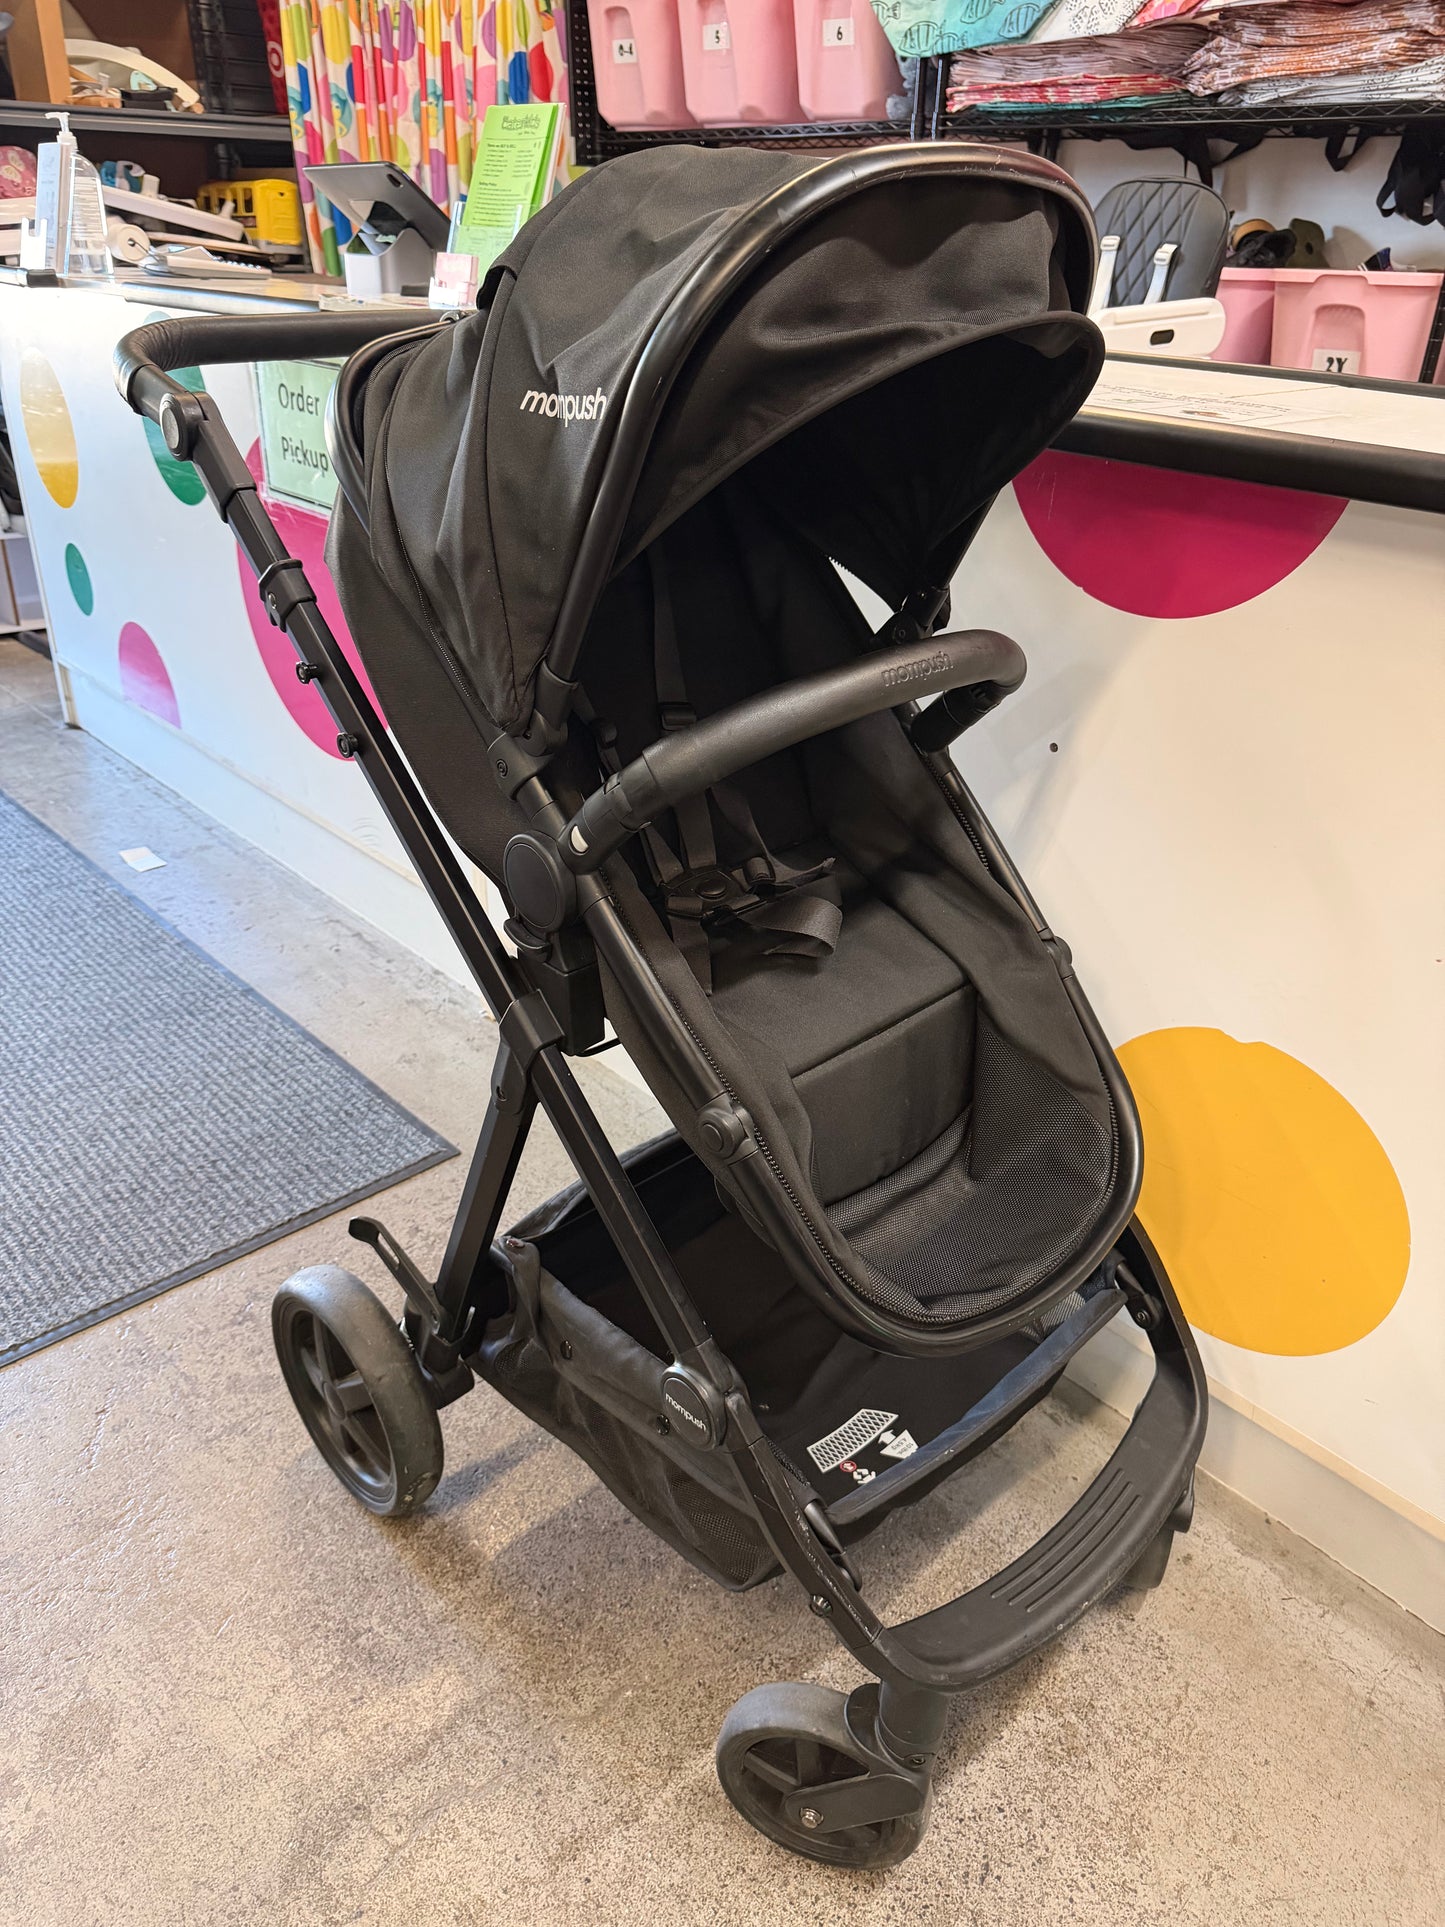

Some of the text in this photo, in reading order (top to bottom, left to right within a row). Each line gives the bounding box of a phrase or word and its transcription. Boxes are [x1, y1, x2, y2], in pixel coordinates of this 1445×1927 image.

[714, 29, 721, 44] 5
[836, 26, 843, 41] 6
[278, 383, 320, 416] Order
[520, 387, 607, 427] mompush
[282, 436, 329, 478] Pickup
[881, 651, 954, 687] mompush
[665, 1393, 707, 1431] mompush
